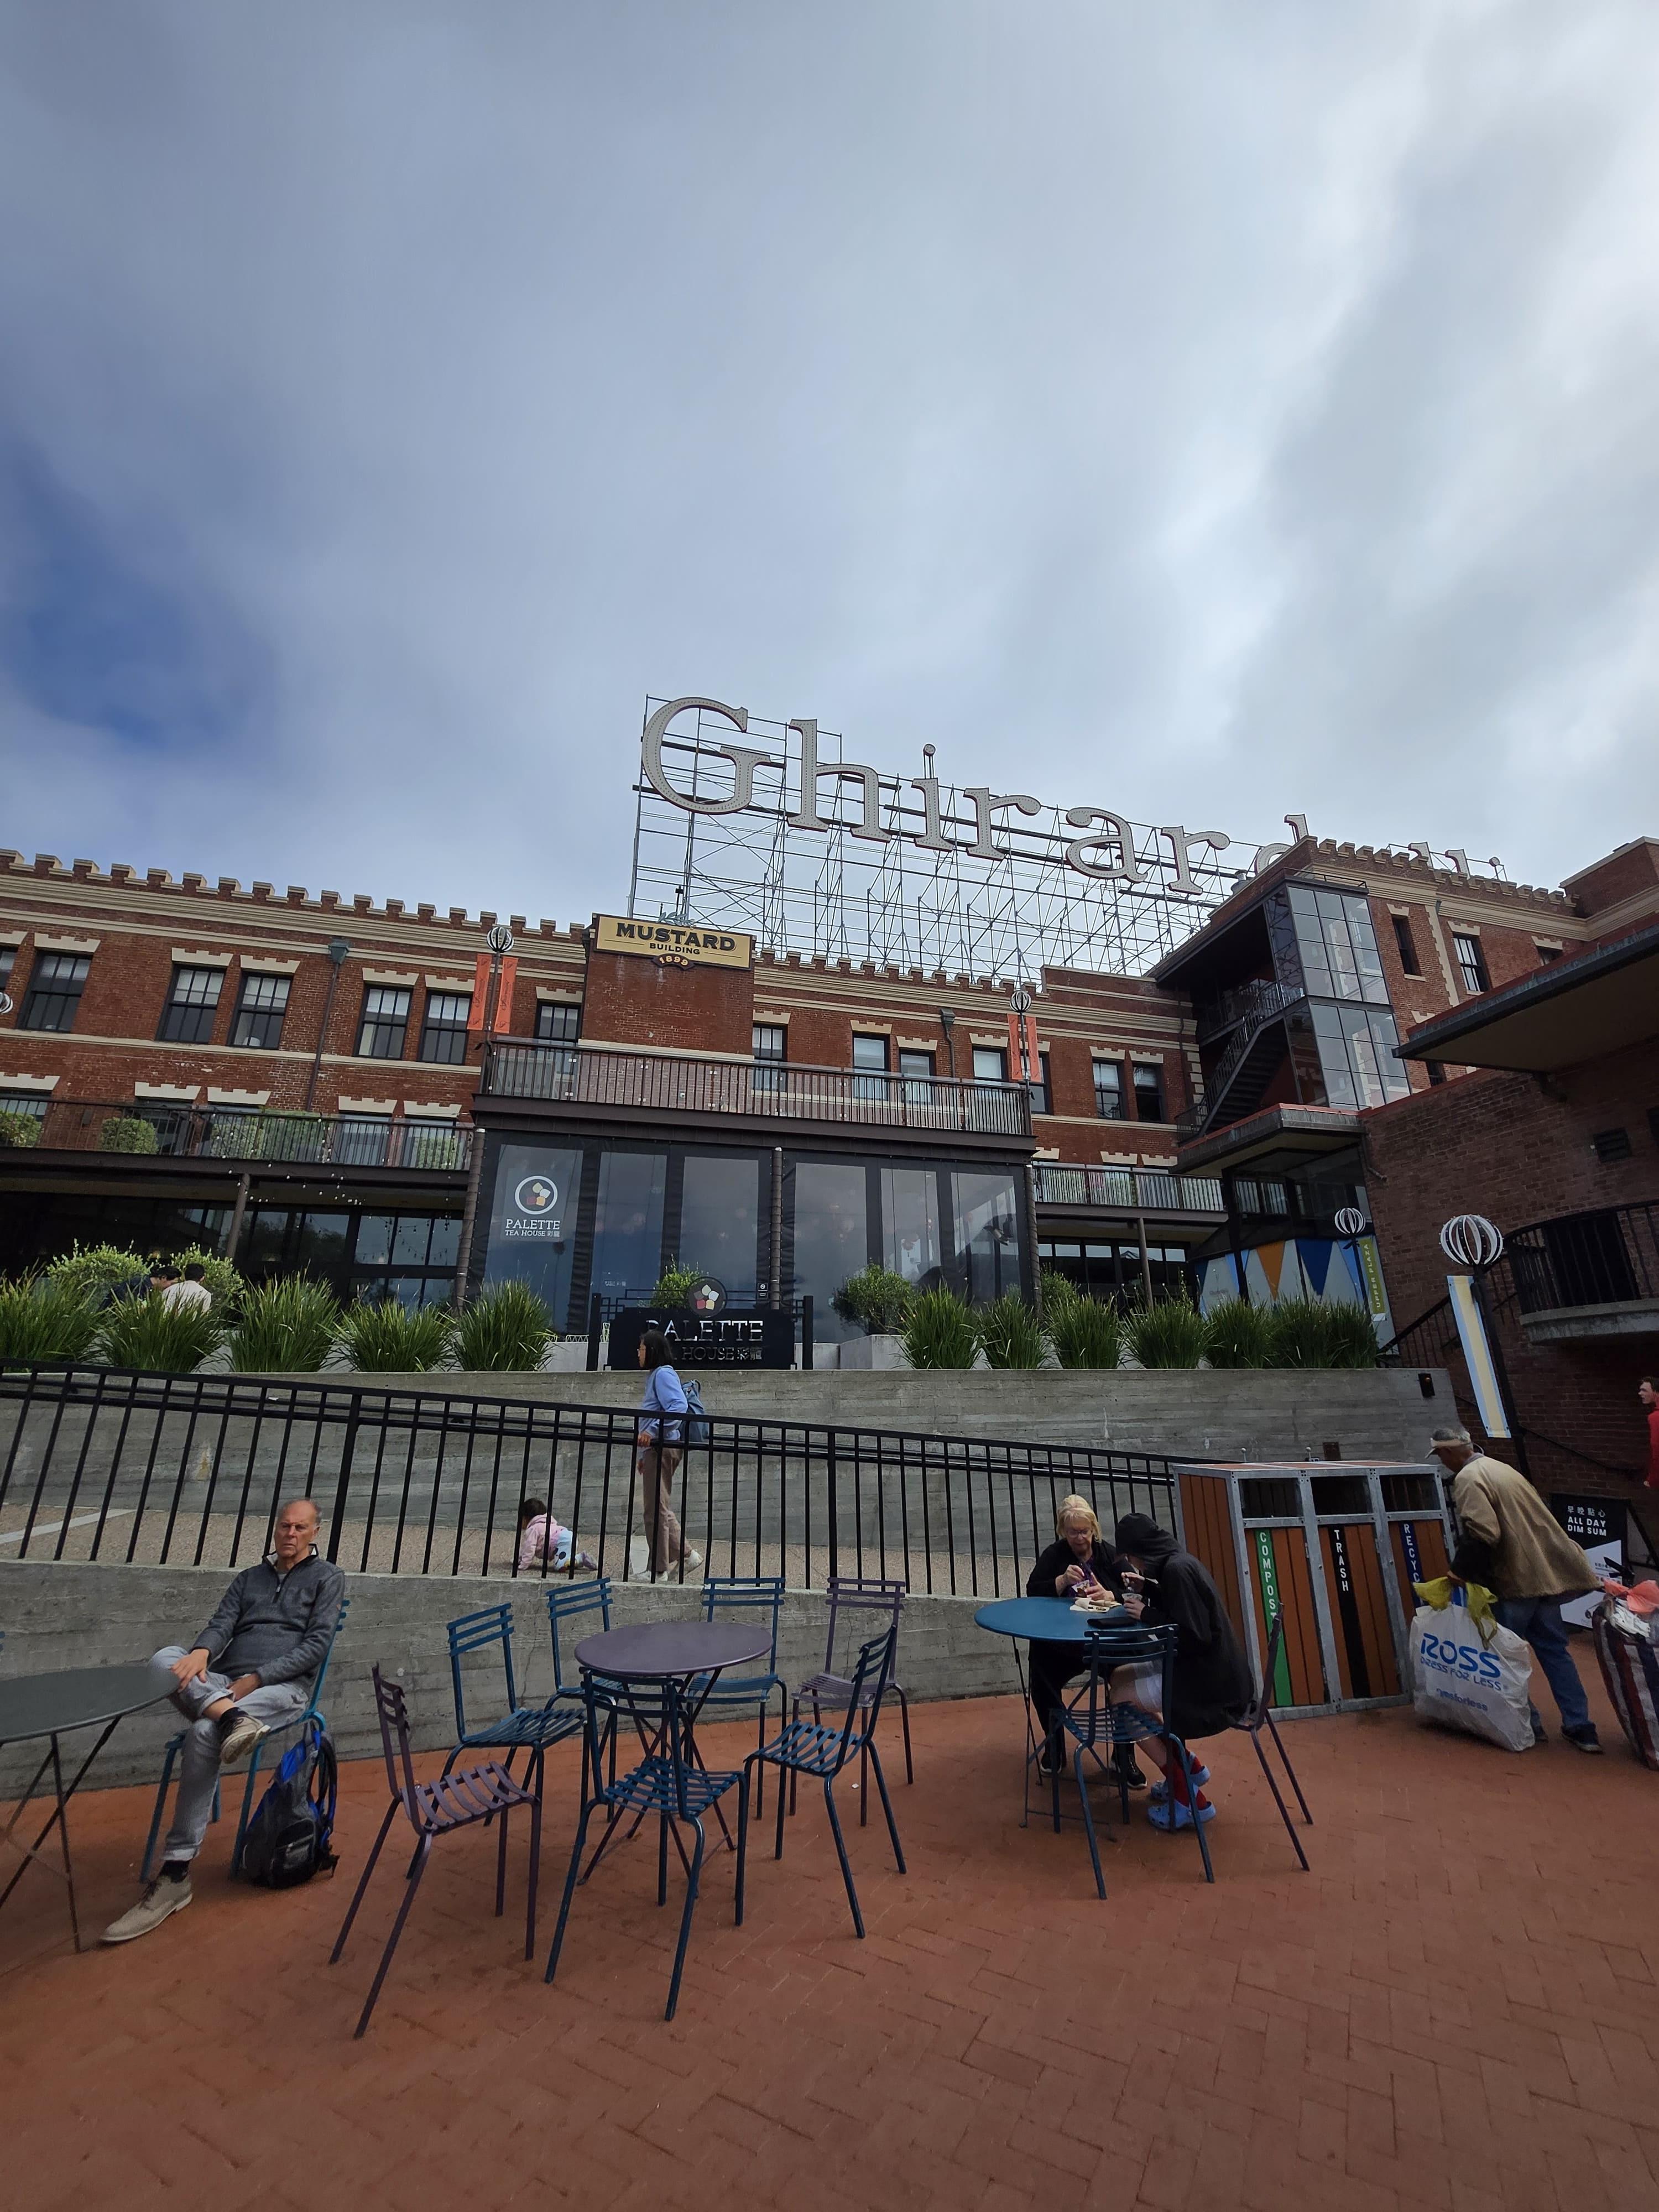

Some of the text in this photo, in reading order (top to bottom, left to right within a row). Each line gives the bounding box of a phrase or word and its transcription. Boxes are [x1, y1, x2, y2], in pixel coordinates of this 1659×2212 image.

[641, 696, 1500, 896] Ghirar
[616, 922, 737, 951] MUSTARD
[649, 943, 700, 955] BUILDING
[659, 955, 688, 966] 1899
[505, 1219, 560, 1230] PALETTE
[1364, 1244, 1381, 1308] UPPER PLAZA
[681, 1347, 734, 1360] HOUSE
[1567, 1525, 1606, 1536] DIM SUM
[1568, 1516, 1606, 1527] ALL DAY
[1334, 1529, 1349, 1592] TRASH
[1404, 1524, 1421, 1583] RECYC
[1420, 1632, 1501, 1678] ROSS
[1420, 1656, 1448, 1674] DRESS
[1450, 1667, 1470, 1682] FOR
